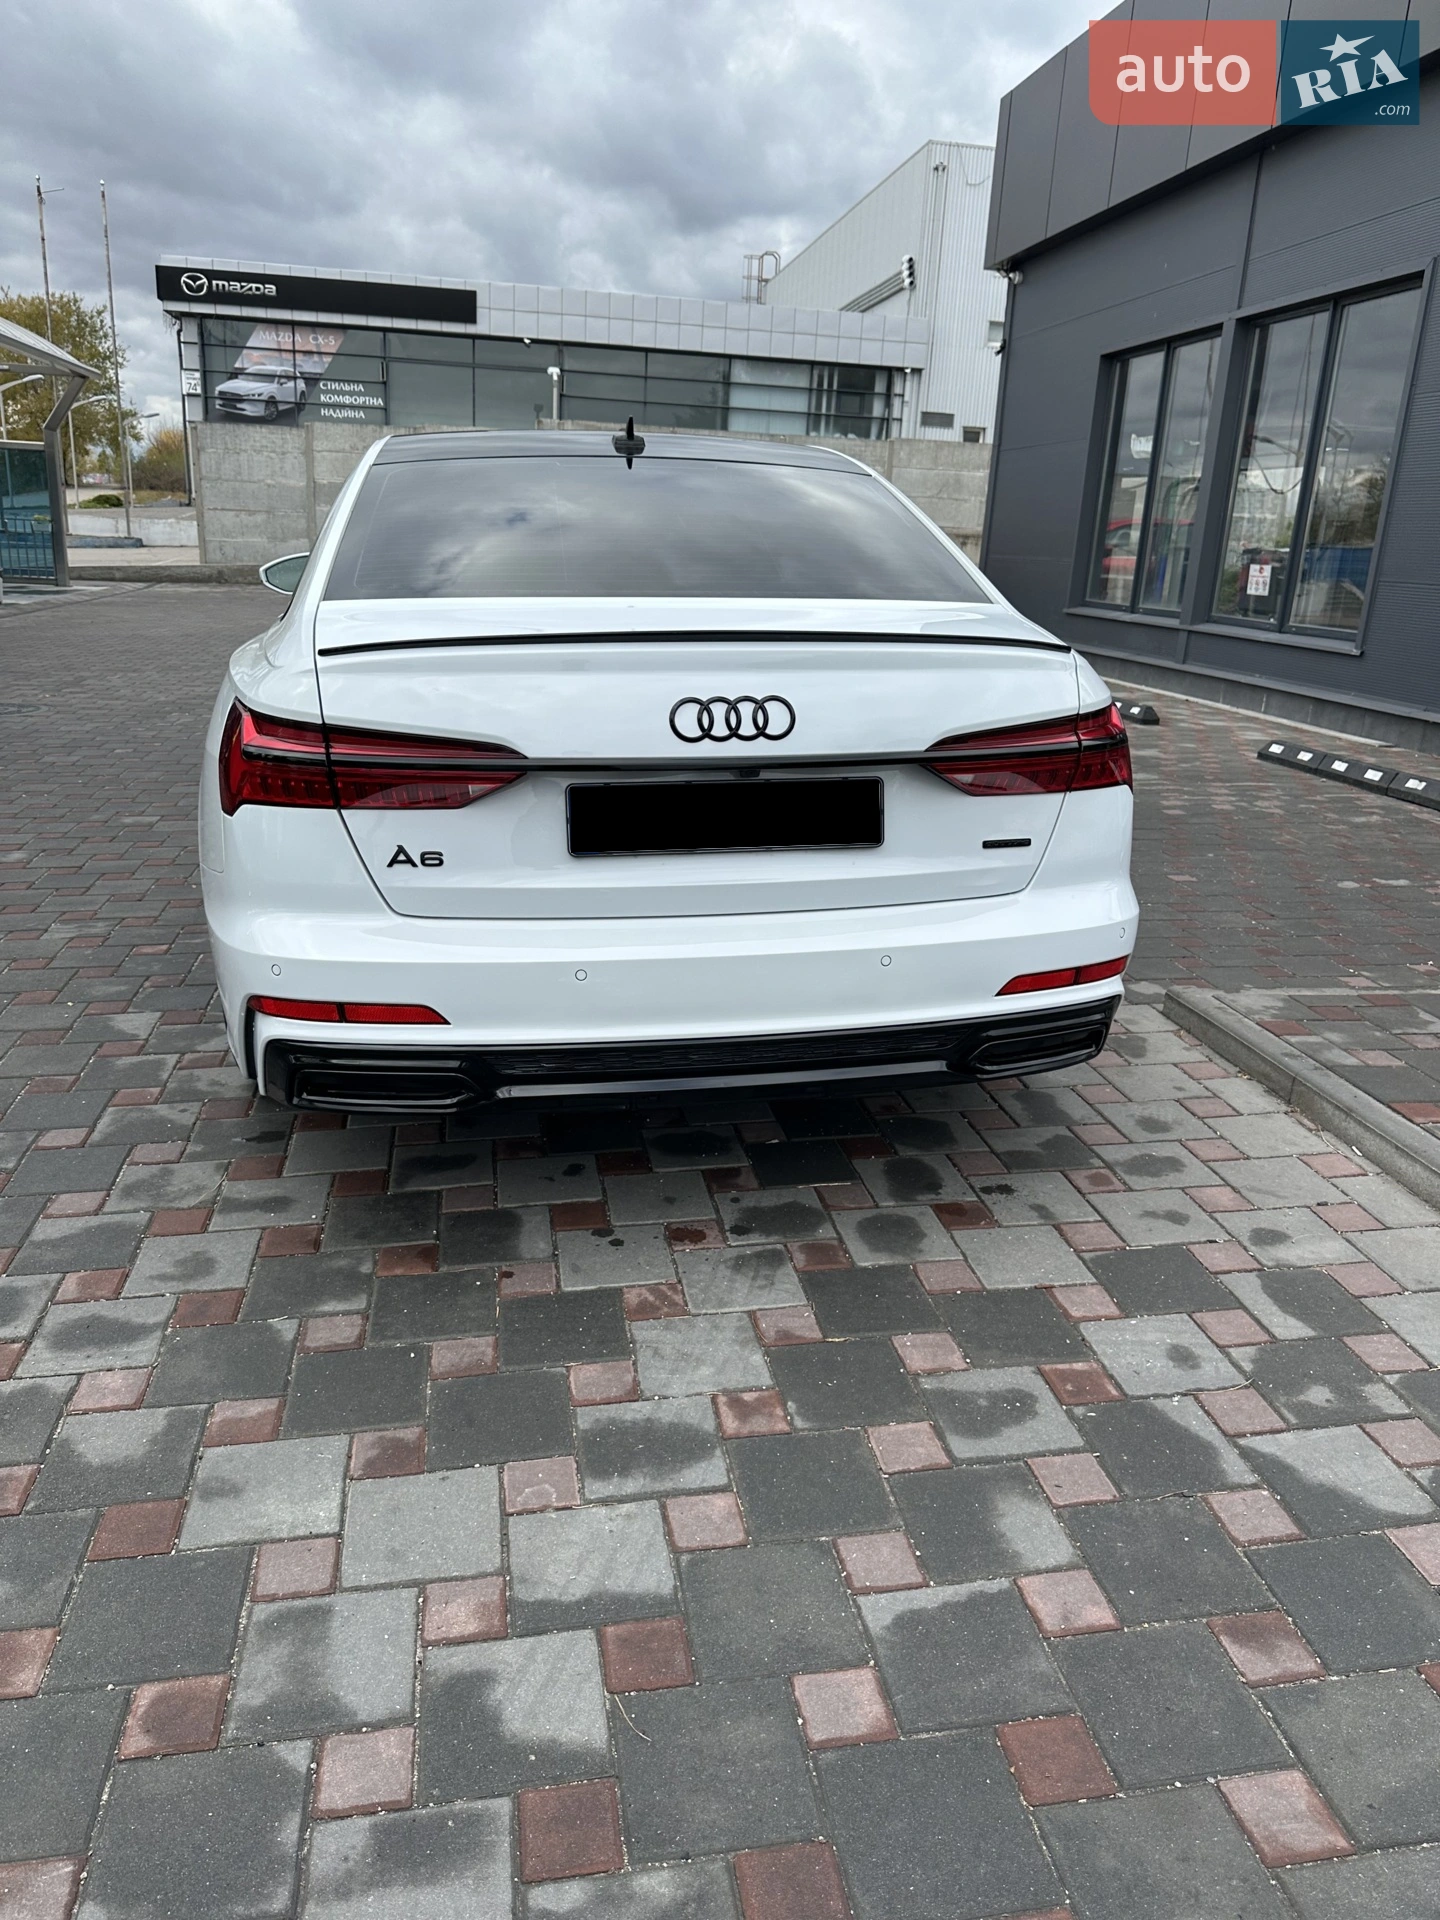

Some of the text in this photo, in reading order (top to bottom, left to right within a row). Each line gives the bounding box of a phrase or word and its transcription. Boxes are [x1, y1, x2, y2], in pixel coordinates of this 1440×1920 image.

[212, 280, 277, 296] mazda
[260, 330, 336, 345] MAZDA CX-5
[320, 381, 364, 392] СТИЛЬНА
[320, 393, 384, 406] КОМФОРТНА
[321, 407, 366, 419] НАДІЙНА
[386, 844, 444, 868] A6
